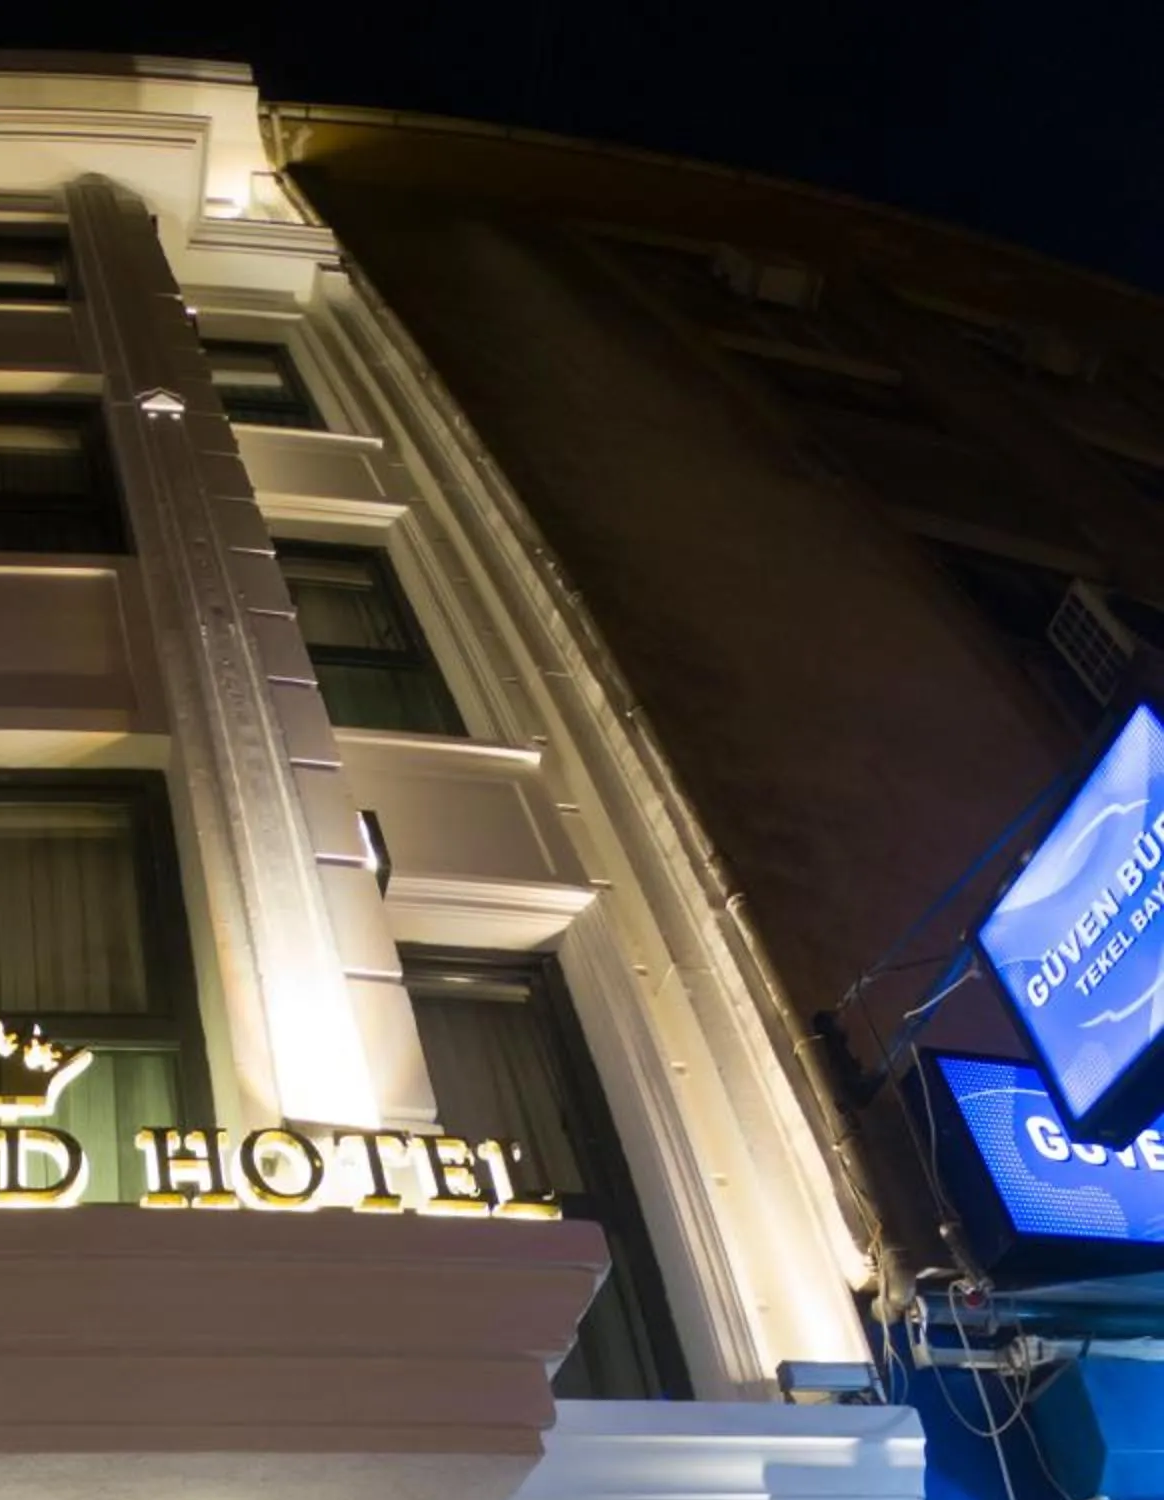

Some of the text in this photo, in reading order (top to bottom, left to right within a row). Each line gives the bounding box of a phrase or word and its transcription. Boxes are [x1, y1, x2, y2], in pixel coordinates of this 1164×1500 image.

[1027, 887, 1121, 1007] GÜVEN
[1075, 930, 1135, 996] TEKEL
[135, 1127, 563, 1220] HOTEL
